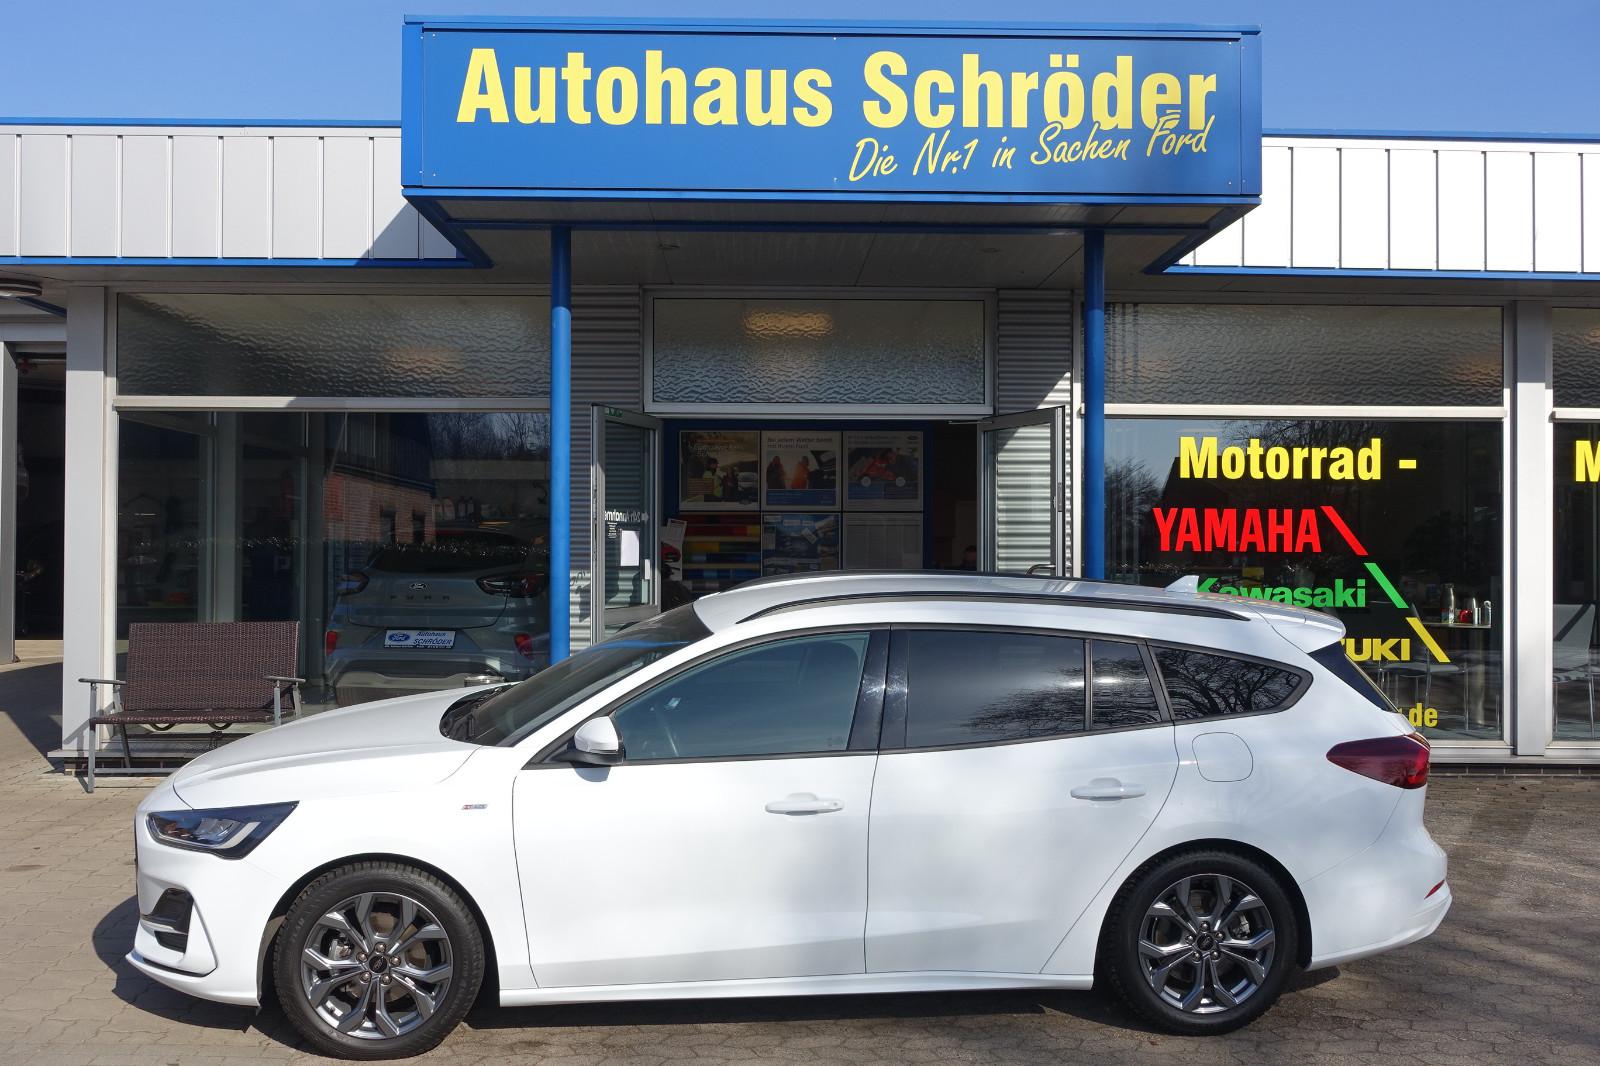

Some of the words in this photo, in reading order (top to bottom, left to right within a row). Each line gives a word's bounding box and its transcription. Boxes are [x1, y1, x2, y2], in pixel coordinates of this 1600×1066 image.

[457, 48, 832, 127] Autohaus
[863, 51, 1217, 131] Schröder
[849, 136, 899, 182] Die
[991, 136, 1017, 171] in
[1029, 121, 1131, 166] Sachen
[1146, 111, 1216, 158] Ford
[1179, 435, 1382, 481] Motorrad
[1153, 506, 1322, 553] YAMAHA
[1340, 638, 1411, 663] UKI
